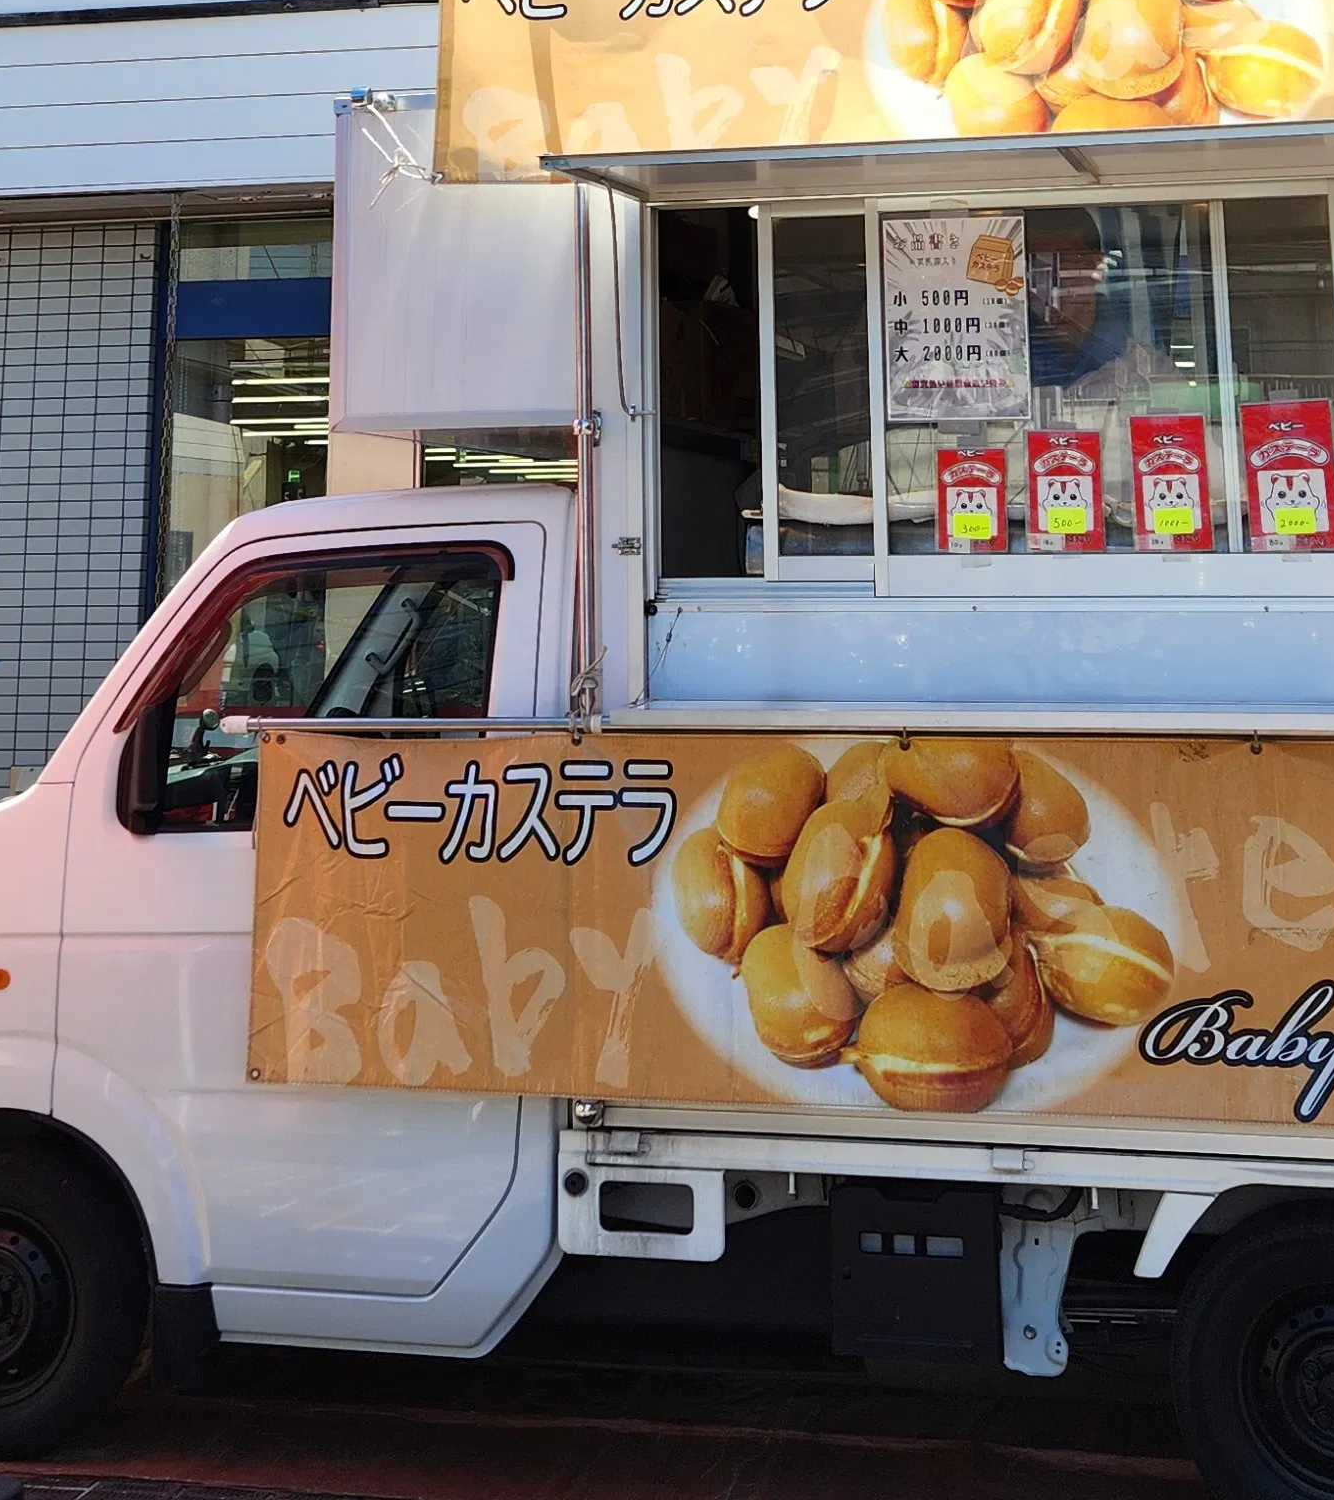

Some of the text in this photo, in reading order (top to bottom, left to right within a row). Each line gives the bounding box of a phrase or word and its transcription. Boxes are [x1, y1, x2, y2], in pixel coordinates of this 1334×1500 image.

[971, 260, 1000, 273] カステラ
[893, 291, 907, 306] 小
[922, 290, 969, 306] 500円
[894, 320, 908, 335] 中
[923, 317, 981, 333] 1000円
[894, 347, 909, 362] 大
[923, 345, 982, 361] 2000円
[1268, 421, 1305, 432] ベビー
[1048, 436, 1079, 445] ベビー
[1152, 434, 1184, 445] ベビー
[1040, 451, 1088, 467] カステーラ
[1145, 451, 1193, 467] カステーラ
[1258, 443, 1321, 461] カステーラ
[948, 464, 995, 480] カステーラ
[283, 753, 677, 866] ベビーカステラ
